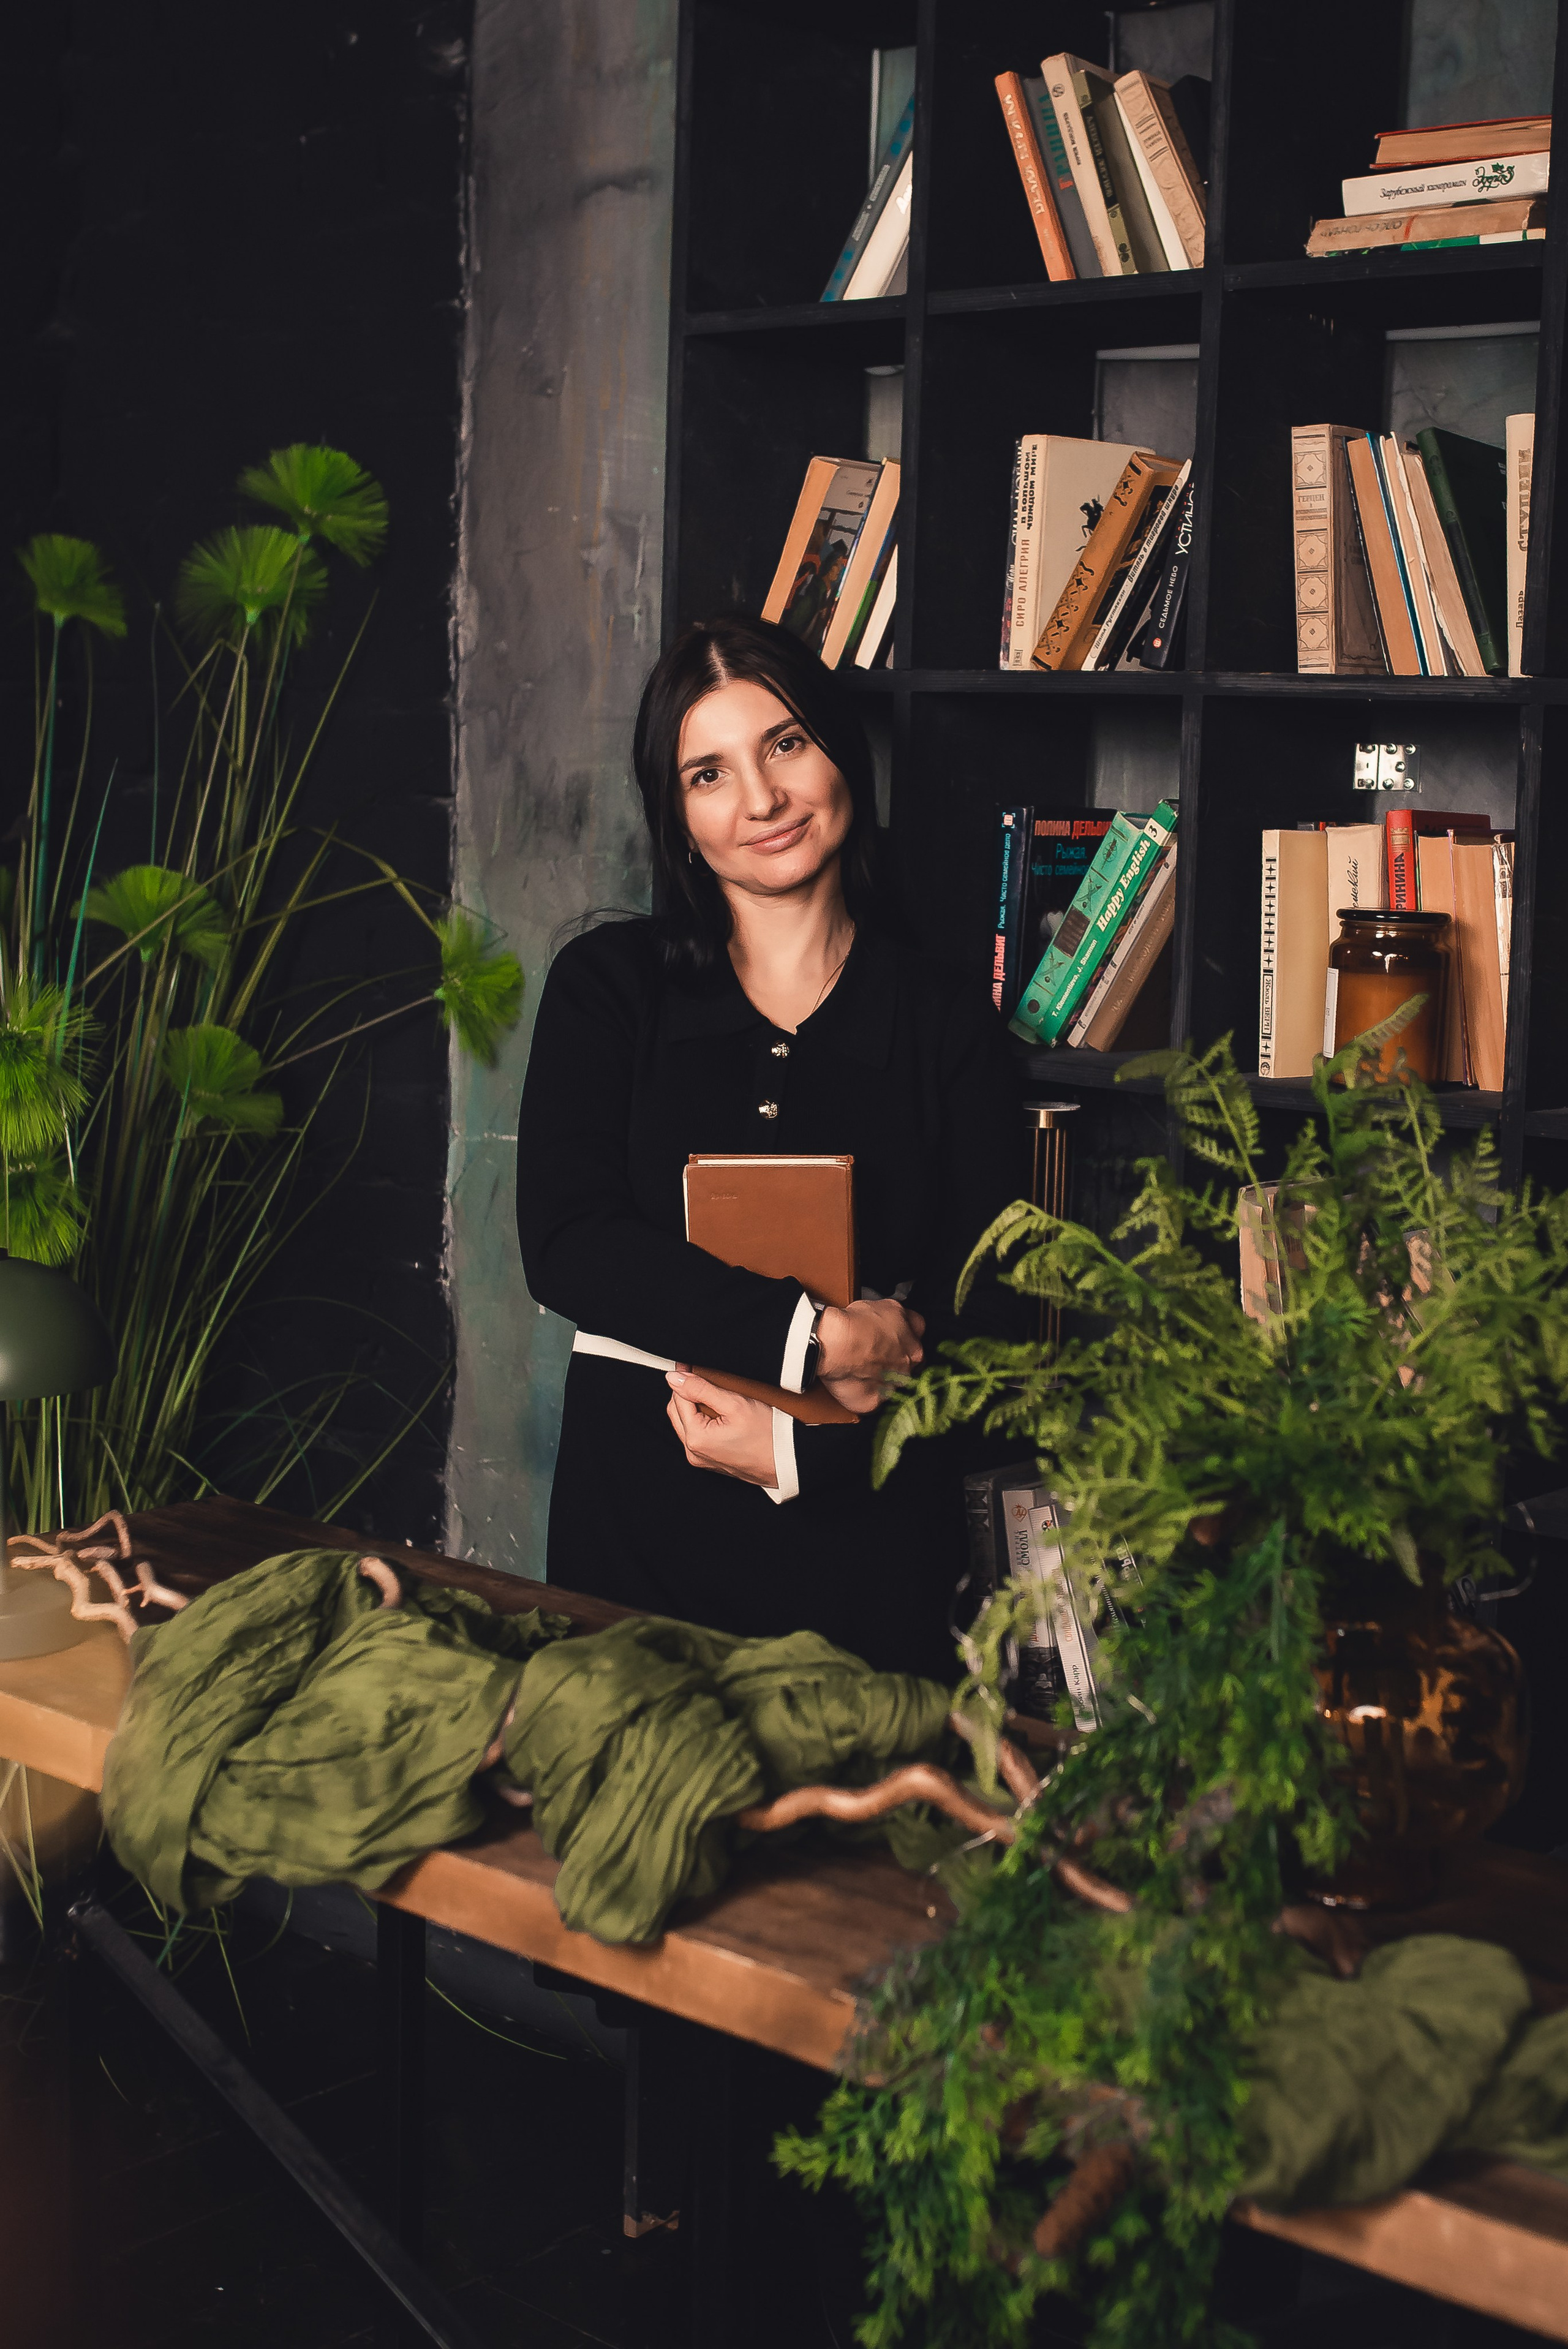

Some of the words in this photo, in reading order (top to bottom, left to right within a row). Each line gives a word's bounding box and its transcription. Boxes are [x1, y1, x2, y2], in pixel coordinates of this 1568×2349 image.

[1030, 444, 1038, 476] МИРЕ
[1022, 451, 1031, 513] БОЛЬШОМ
[1297, 494, 1325, 503] ГЕРЦЕН
[1026, 479, 1036, 530] ЧУЖДОМ
[1128, 552, 1146, 584] Витязь
[1145, 508, 1167, 548] тигровой
[1017, 538, 1031, 592] АЛЕГРИЯ
[1016, 595, 1027, 627] СИРО
[1158, 590, 1173, 630] СЕДЬМОЕ
[1168, 565, 1179, 588] НЕБО
[1515, 590, 1525, 629] Лазарь
[1034, 820, 1071, 837] ПОЛИНА
[1148, 823, 1158, 838] 3
[1000, 881, 1008, 902] Чисто
[1096, 889, 1126, 932] Happy
[1121, 839, 1151, 888] English
[992, 933, 1006, 981] ДЕЛЬВИГ
[1080, 938, 1098, 967] Shannon
[1018, 1529, 1031, 1566] СМОЛЛ
[1070, 1664, 1082, 1685] Карр
